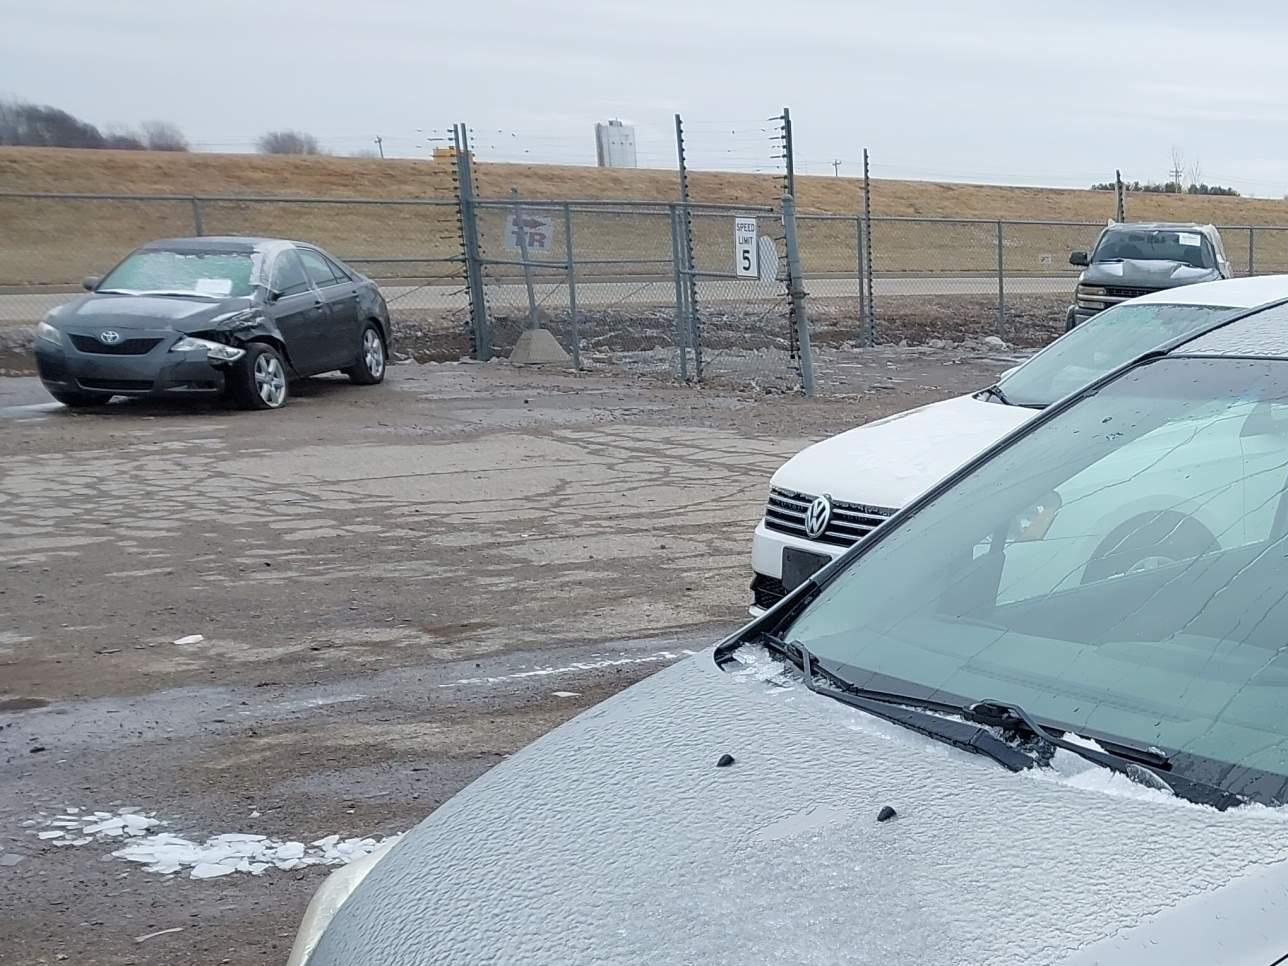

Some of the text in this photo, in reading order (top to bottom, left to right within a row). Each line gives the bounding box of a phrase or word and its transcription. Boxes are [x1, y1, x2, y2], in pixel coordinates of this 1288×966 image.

[736, 223, 755, 232] SPEED
[738, 235, 753, 245] LIMIT
[742, 249, 751, 271] 5
